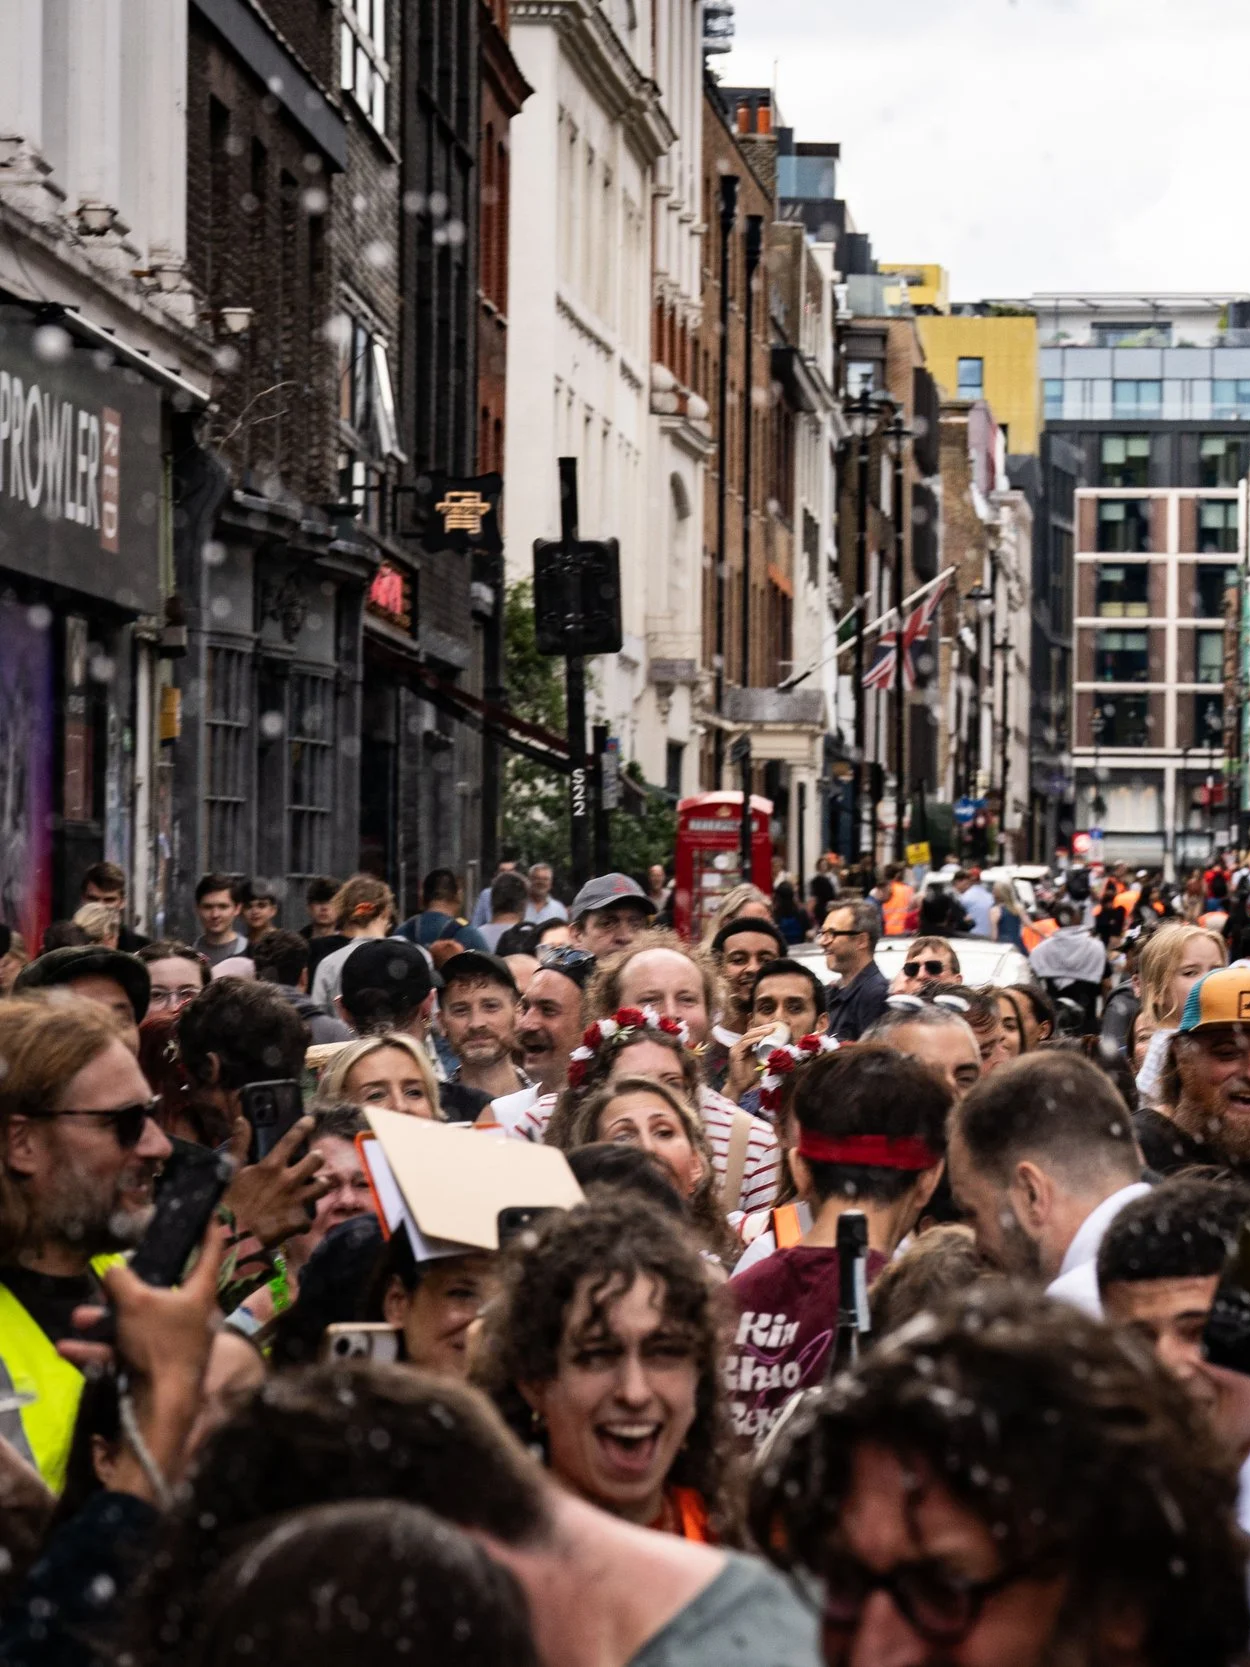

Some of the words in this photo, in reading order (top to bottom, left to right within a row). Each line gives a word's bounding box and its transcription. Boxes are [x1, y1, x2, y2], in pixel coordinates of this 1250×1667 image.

[0, 370, 100, 530] PROWLER
[572, 768, 586, 816] S22
[735, 1311, 800, 1348] Kin
